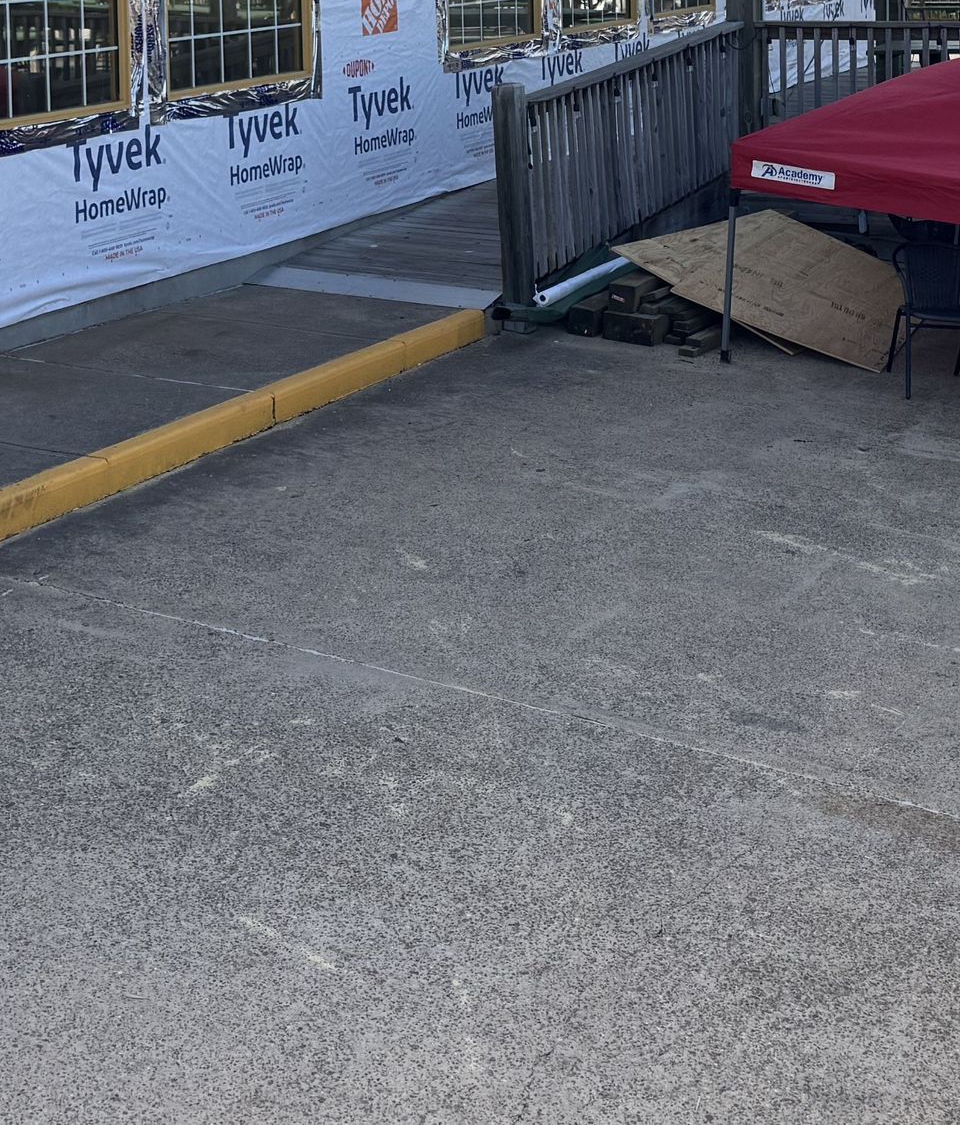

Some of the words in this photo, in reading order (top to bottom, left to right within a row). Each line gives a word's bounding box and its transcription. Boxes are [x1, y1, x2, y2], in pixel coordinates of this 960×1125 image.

[345, 59, 371, 78] DUPONT
[454, 64, 504, 106] Tyvek
[542, 50, 583, 86] Tyvek
[348, 76, 413, 130] Tyvek
[223, 103, 299, 158] Tyvek
[354, 127, 415, 155] HomeWrap
[66, 124, 162, 192] Tyvek
[230, 154, 303, 186] HomeWrap
[778, 167, 824, 185] Academy
[75, 186, 168, 224] HomeWrap
